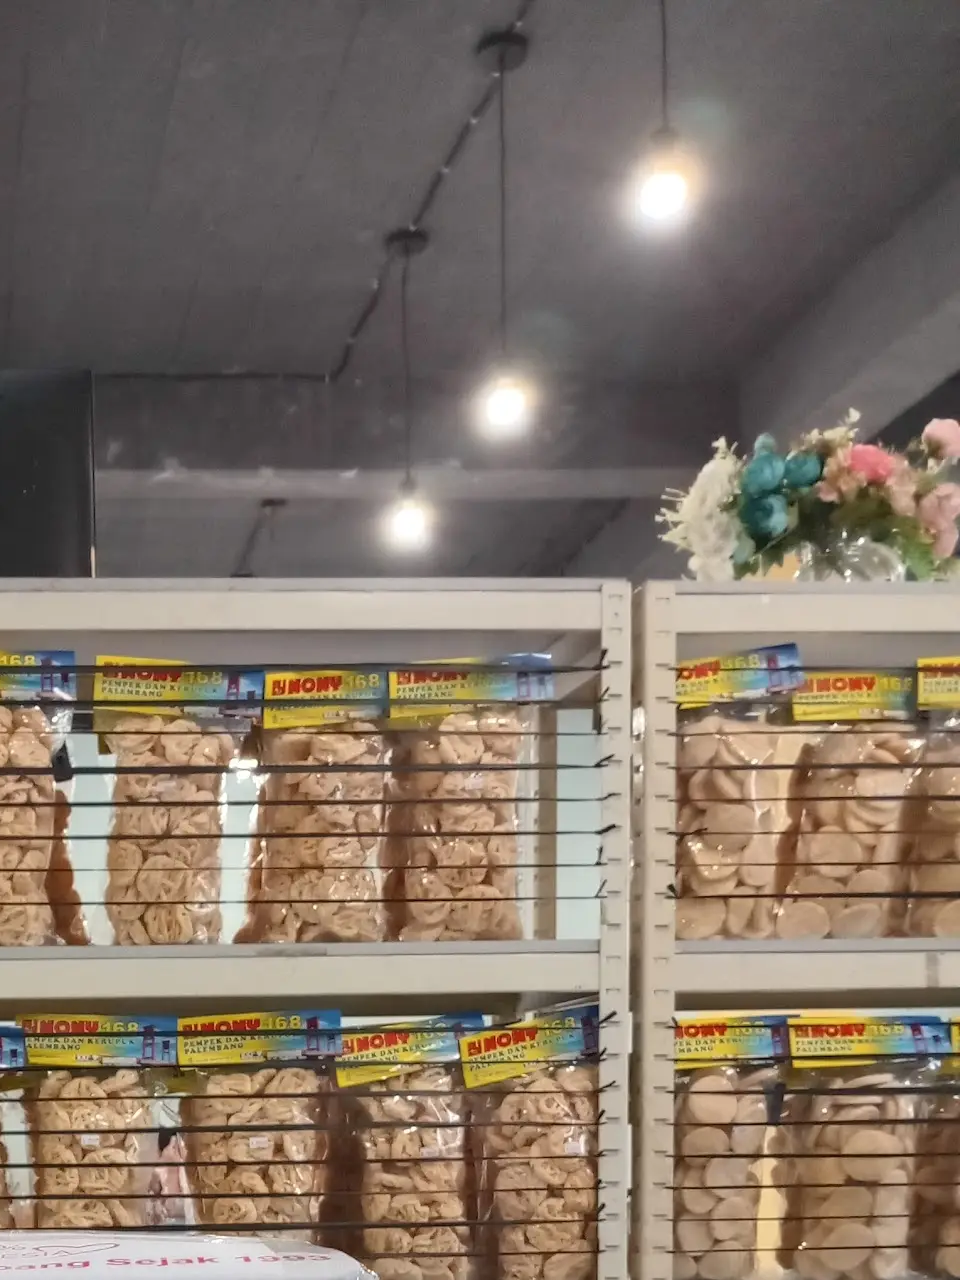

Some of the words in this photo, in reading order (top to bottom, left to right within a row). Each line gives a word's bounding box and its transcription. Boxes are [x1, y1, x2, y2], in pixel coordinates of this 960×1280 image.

[27, 1042, 81, 1051] ALEMBANG
[106, 1256, 220, 1268] Sejak
[235, 1255, 332, 1264] 1993
